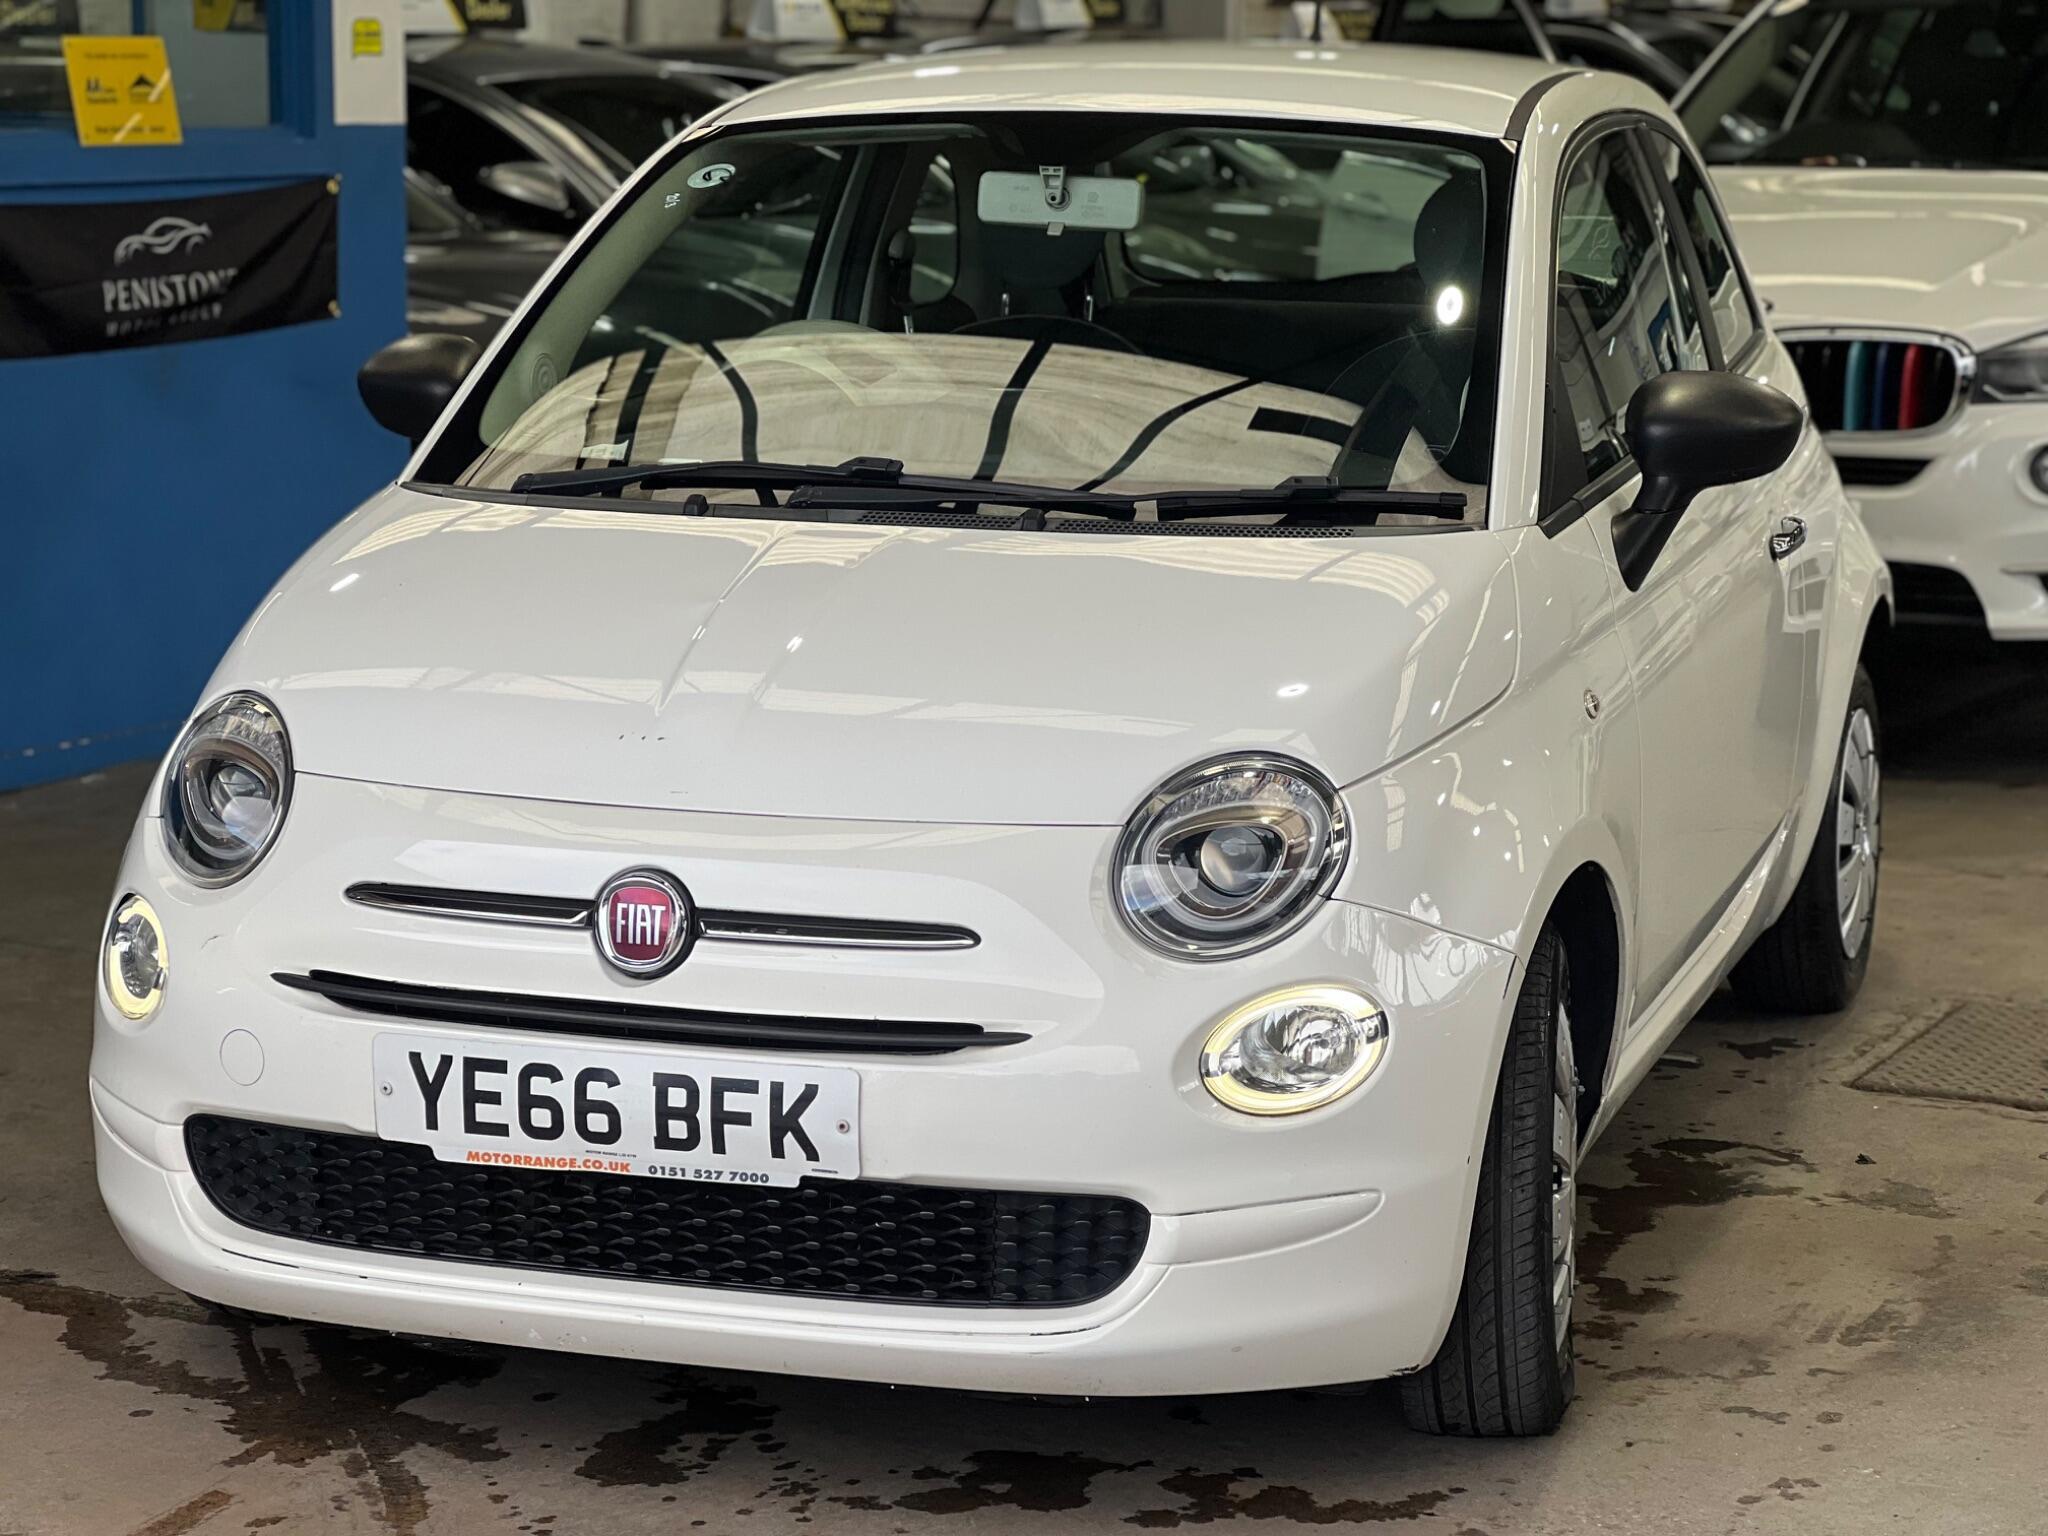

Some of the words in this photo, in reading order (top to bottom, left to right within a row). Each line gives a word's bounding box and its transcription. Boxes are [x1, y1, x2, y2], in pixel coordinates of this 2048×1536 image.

[102, 267, 238, 313] PENISTON
[616, 902, 667, 946] FIAT
[408, 1051, 623, 1146] YE66
[652, 1071, 820, 1163] BFK
[466, 1150, 632, 1173] MOTORRANGE.CO.UK
[648, 1165, 687, 1178] 0151
[693, 1169, 724, 1181] 527
[729, 1171, 770, 1184] 7000
